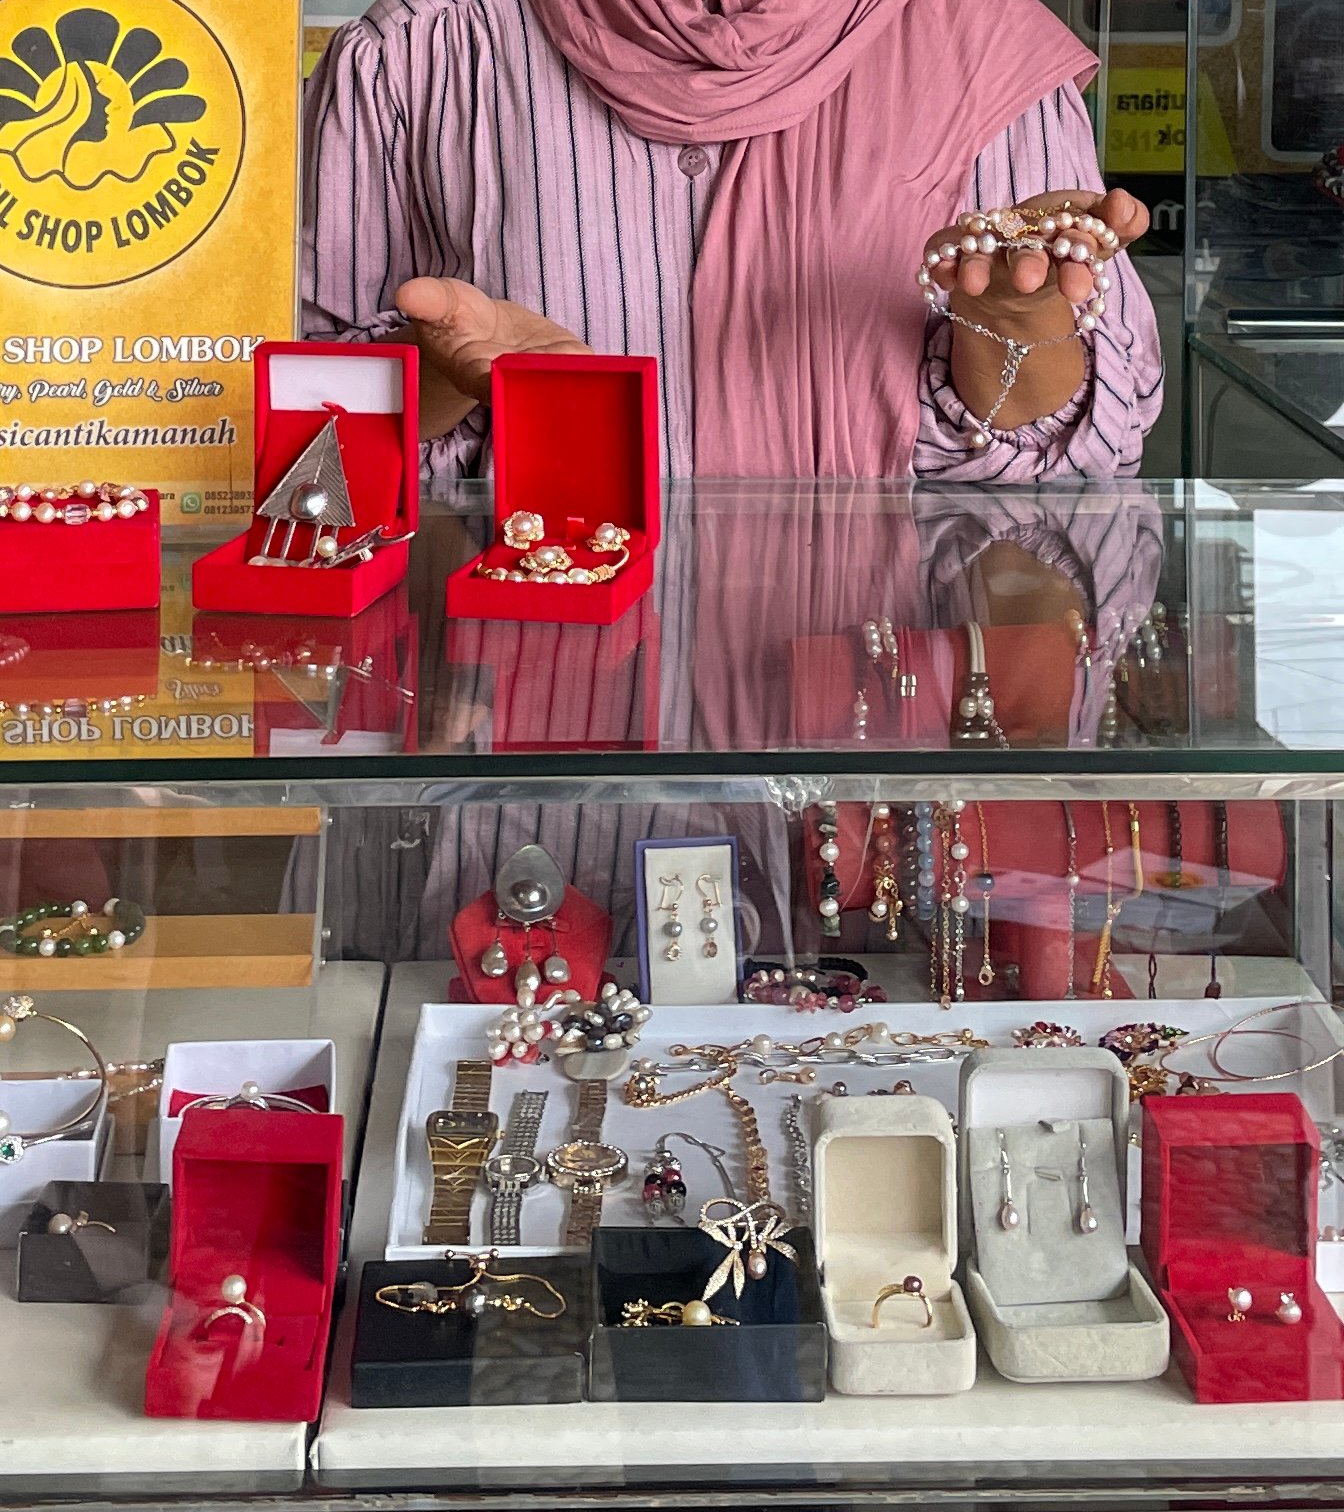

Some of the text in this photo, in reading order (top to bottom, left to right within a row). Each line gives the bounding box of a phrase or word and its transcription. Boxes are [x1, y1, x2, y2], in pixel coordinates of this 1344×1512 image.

[16, 208, 103, 254] SHOP
[111, 136, 221, 249] LOMBOK
[3, 336, 103, 365] SHOP
[112, 336, 264, 364] LOMBOK
[28, 378, 88, 403] Pearl,
[93, 378, 144, 407] Gold
[147, 380, 163, 402] &
[166, 377, 224, 404] Silver
